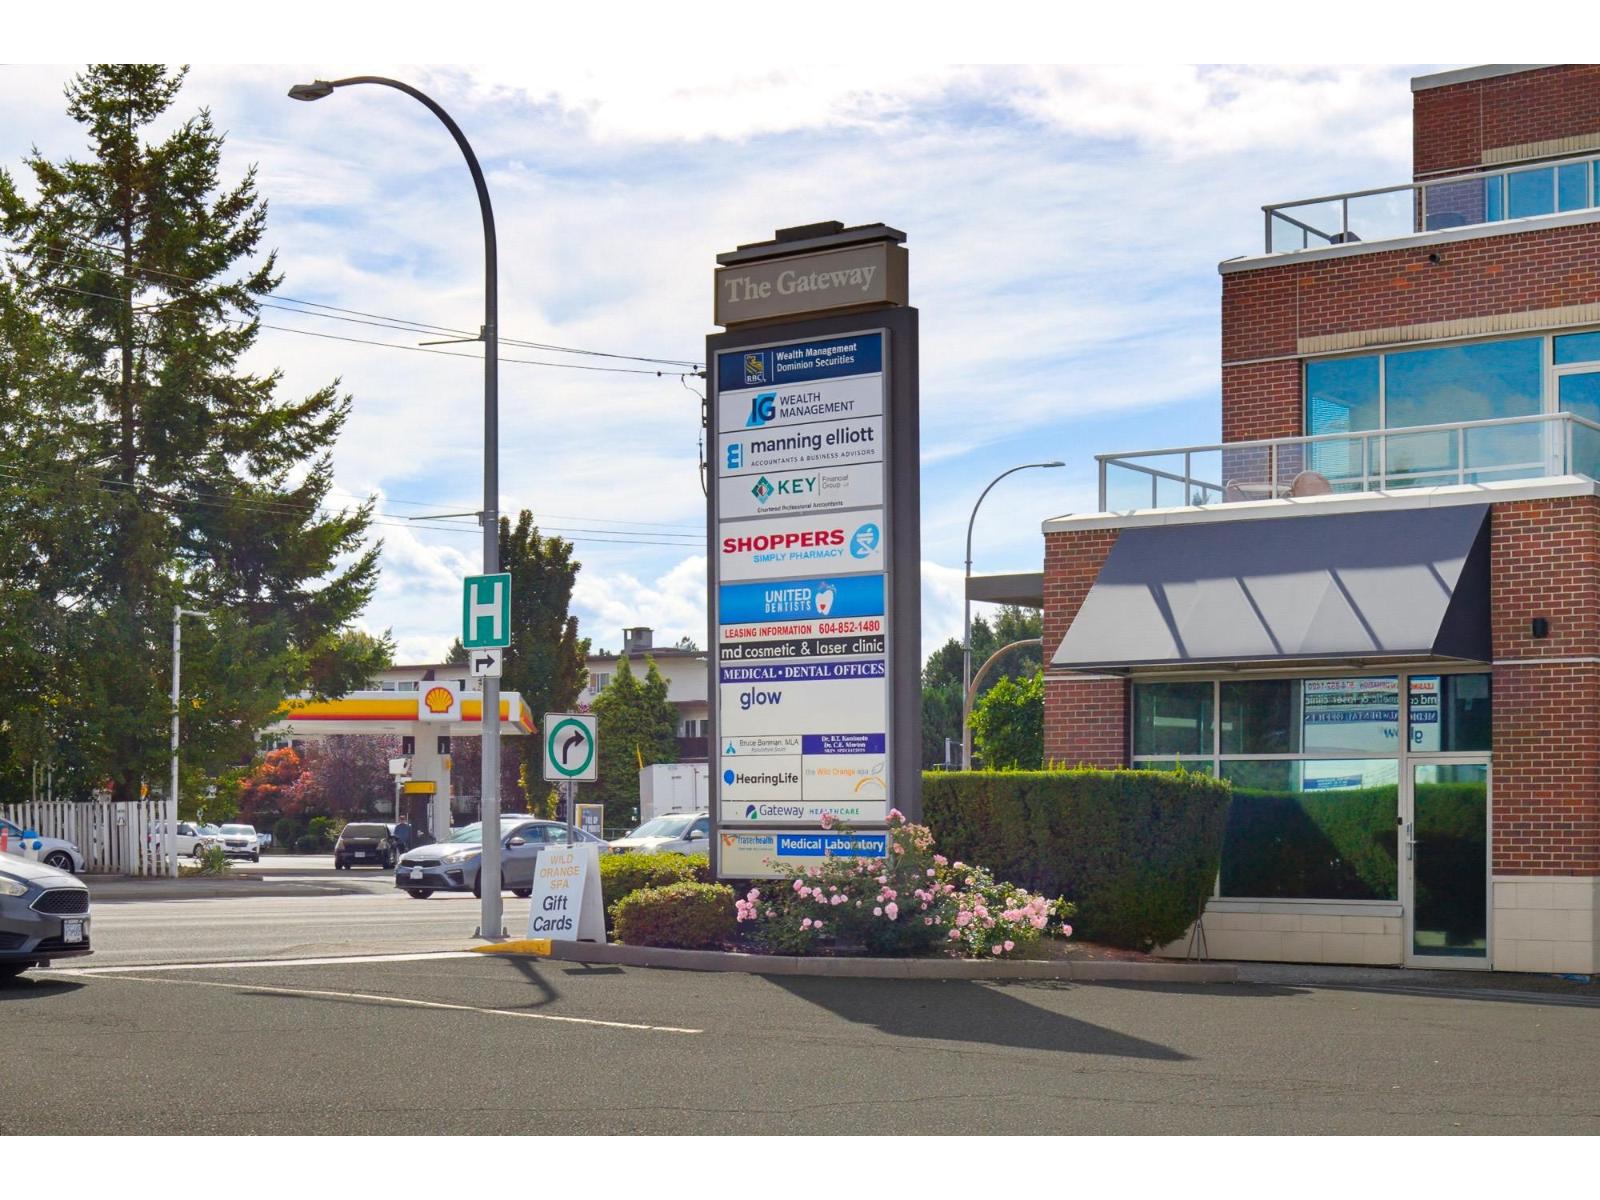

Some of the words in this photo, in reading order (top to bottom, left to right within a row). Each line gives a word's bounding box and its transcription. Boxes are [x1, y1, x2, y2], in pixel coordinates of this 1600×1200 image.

[725, 277, 771, 302] The
[776, 265, 877, 295] Gateway
[776, 350, 804, 361] Wealth
[805, 343, 857, 357] Management
[776, 360, 813, 372] Dominion
[815, 355, 855, 367] Securities
[779, 392, 821, 405] WEALTH
[751, 396, 776, 422] IG
[779, 401, 854, 418] MANAGEMENT
[751, 433, 822, 453] manning
[826, 426, 874, 446] elliott
[751, 456, 798, 467] ACCOUNTANTS
[806, 453, 839, 462] BUSINESS
[841, 449, 875, 457] ADVISORS
[778, 477, 817, 495] KEY
[722, 529, 844, 554] SHOPPERS
[753, 553, 786, 564] SIMPLY
[789, 549, 844, 561] PHARMACY
[765, 588, 811, 603] UNITED
[469, 582, 503, 640] H
[765, 600, 811, 614] DENTISTS
[725, 627, 757, 639] LEASING
[759, 624, 812, 636] INFORMATION
[819, 620, 880, 634] 604-852-1480
[721, 645, 742, 659] md
[744, 643, 796, 658] cosmetic
[800, 641, 810, 655] &
[816, 641, 847, 654] laser
[852, 638, 883, 652] clinic
[723, 668, 777, 680] MEDICAL
[785, 665, 831, 678] DENTAL
[833, 663, 885, 676] OFFICES
[740, 686, 782, 710] glow
[785, 738, 799, 746] MLA
[736, 772, 799, 786] HearingLife
[759, 804, 804, 818] Gateway
[781, 838, 821, 849] Medical
[550, 854, 573, 865] WILD
[540, 866, 580, 878] ORANGE
[550, 879, 569, 890] SPA
[542, 895, 569, 911] Gift
[533, 914, 573, 932] Cards
